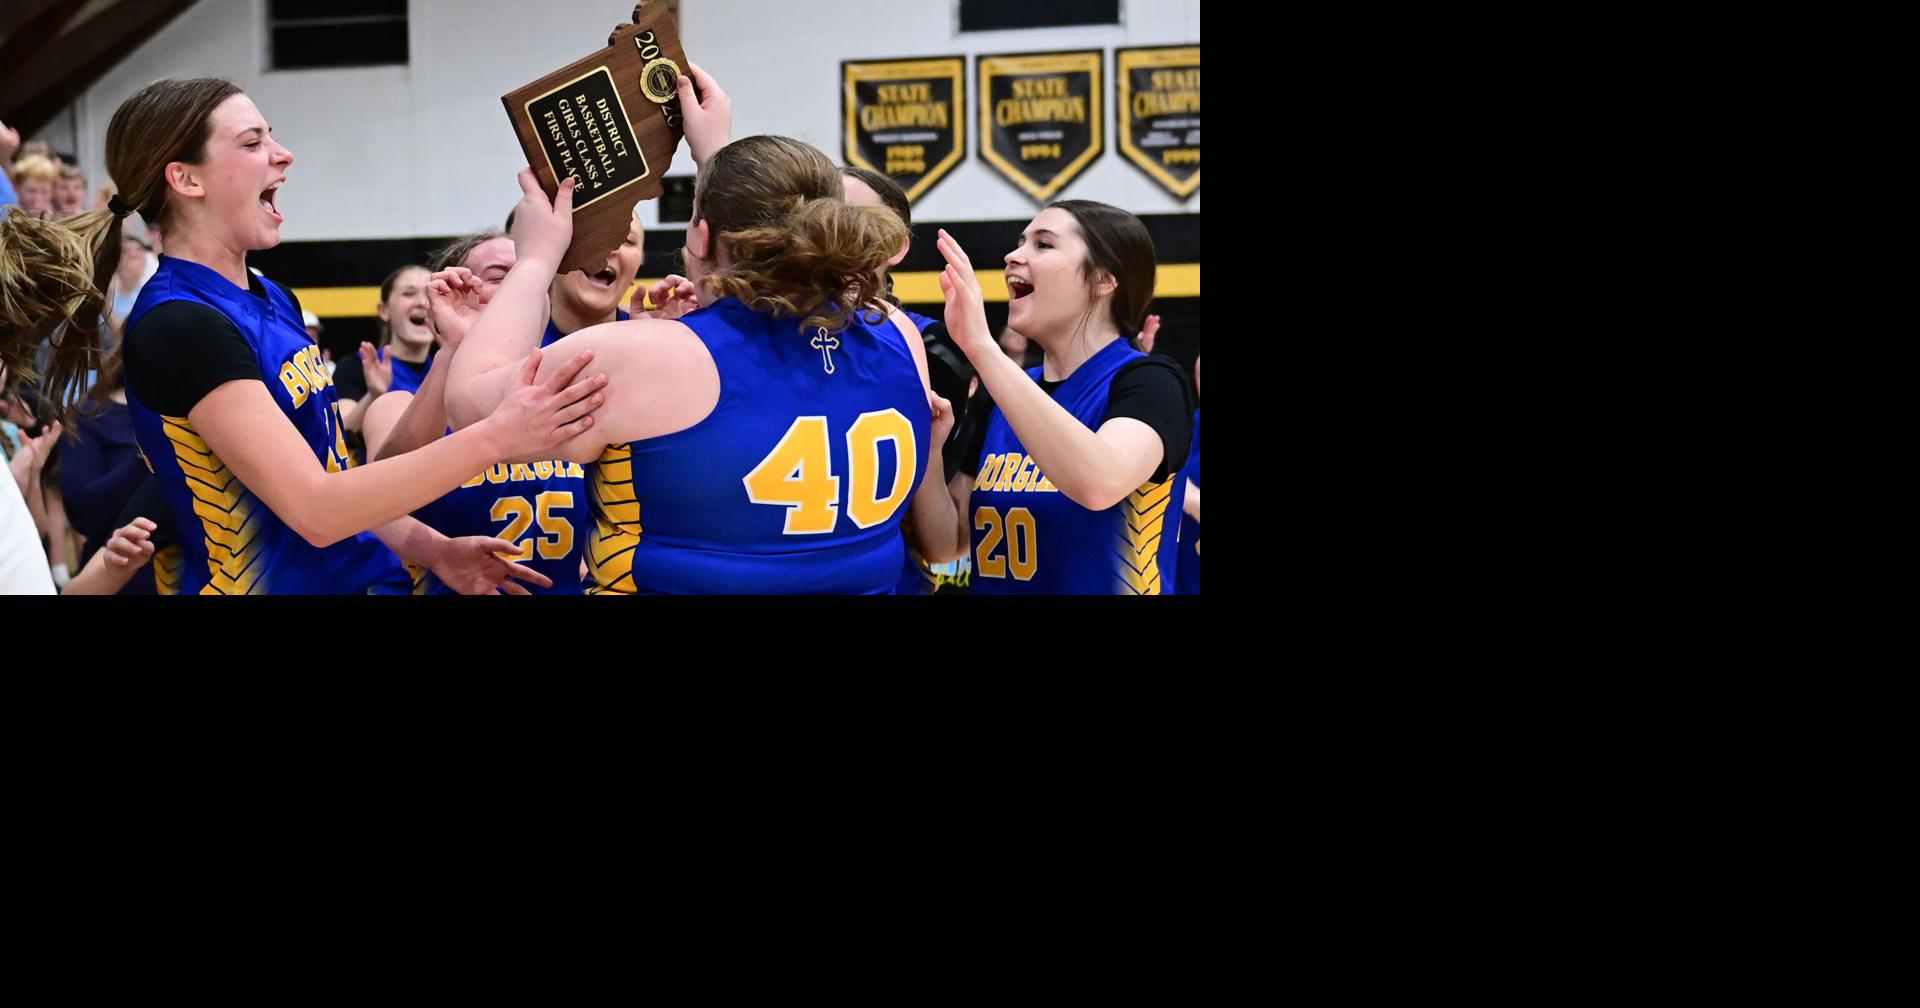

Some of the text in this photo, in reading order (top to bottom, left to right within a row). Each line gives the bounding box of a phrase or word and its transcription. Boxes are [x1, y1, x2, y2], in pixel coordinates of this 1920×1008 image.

[635, 31, 659, 60] 20
[861, 101, 947, 131] CHAMPION
[877, 83, 931, 103] STATE
[996, 96, 1085, 127] CHAMPION
[1012, 78, 1068, 97] STATE
[544, 110, 585, 192] FIRST PLACE
[558, 98, 603, 189] GIRLS CLASS 4
[575, 94, 617, 178] BASKETBALL
[596, 98, 628, 158] DISTRICT
[742, 407, 917, 535] 40
[489, 490, 574, 563] 25
[974, 506, 1038, 581] 20
